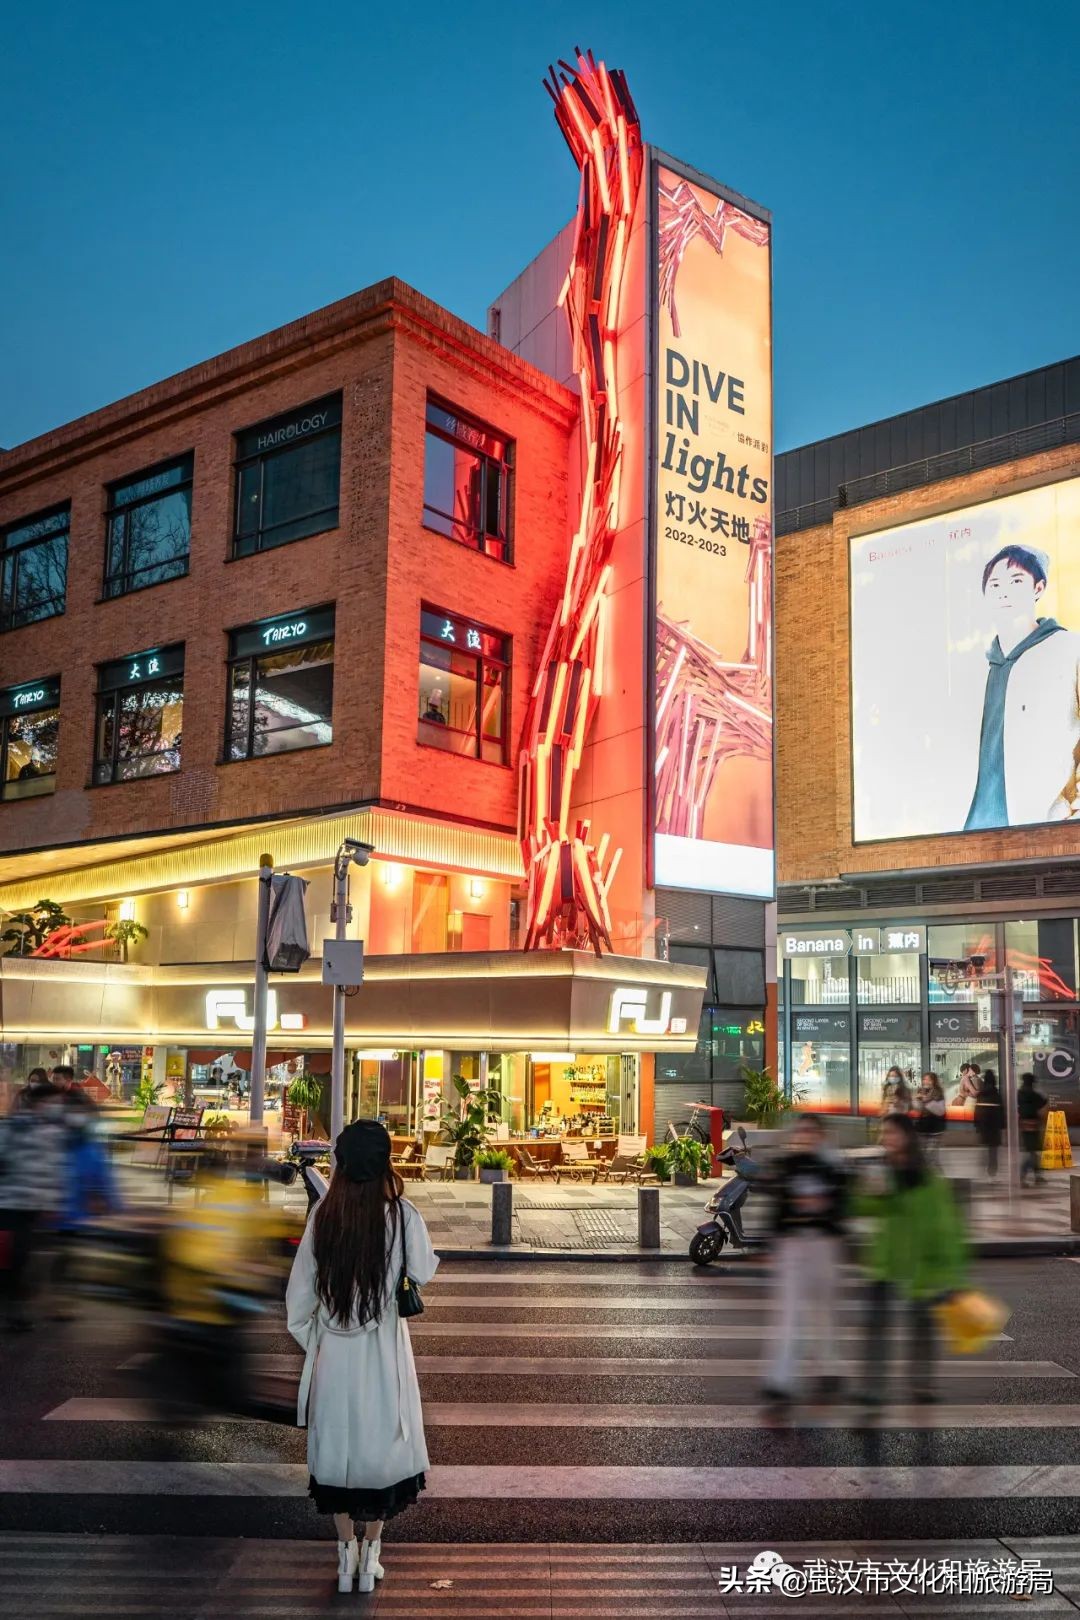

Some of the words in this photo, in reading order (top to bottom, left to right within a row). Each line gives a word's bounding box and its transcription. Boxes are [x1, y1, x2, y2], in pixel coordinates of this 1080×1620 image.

[666, 348, 745, 416] DIVE
[257, 411, 328, 449] HAIROLOGY
[666, 388, 699, 436] IN
[661, 431, 768, 504] lights
[665, 490, 751, 545] 灯火天地
[664, 526, 727, 557] 2022-2023
[263, 622, 306, 645] TAIRYO
[785, 937, 844, 953] Banana
[858, 934, 873, 950] in
